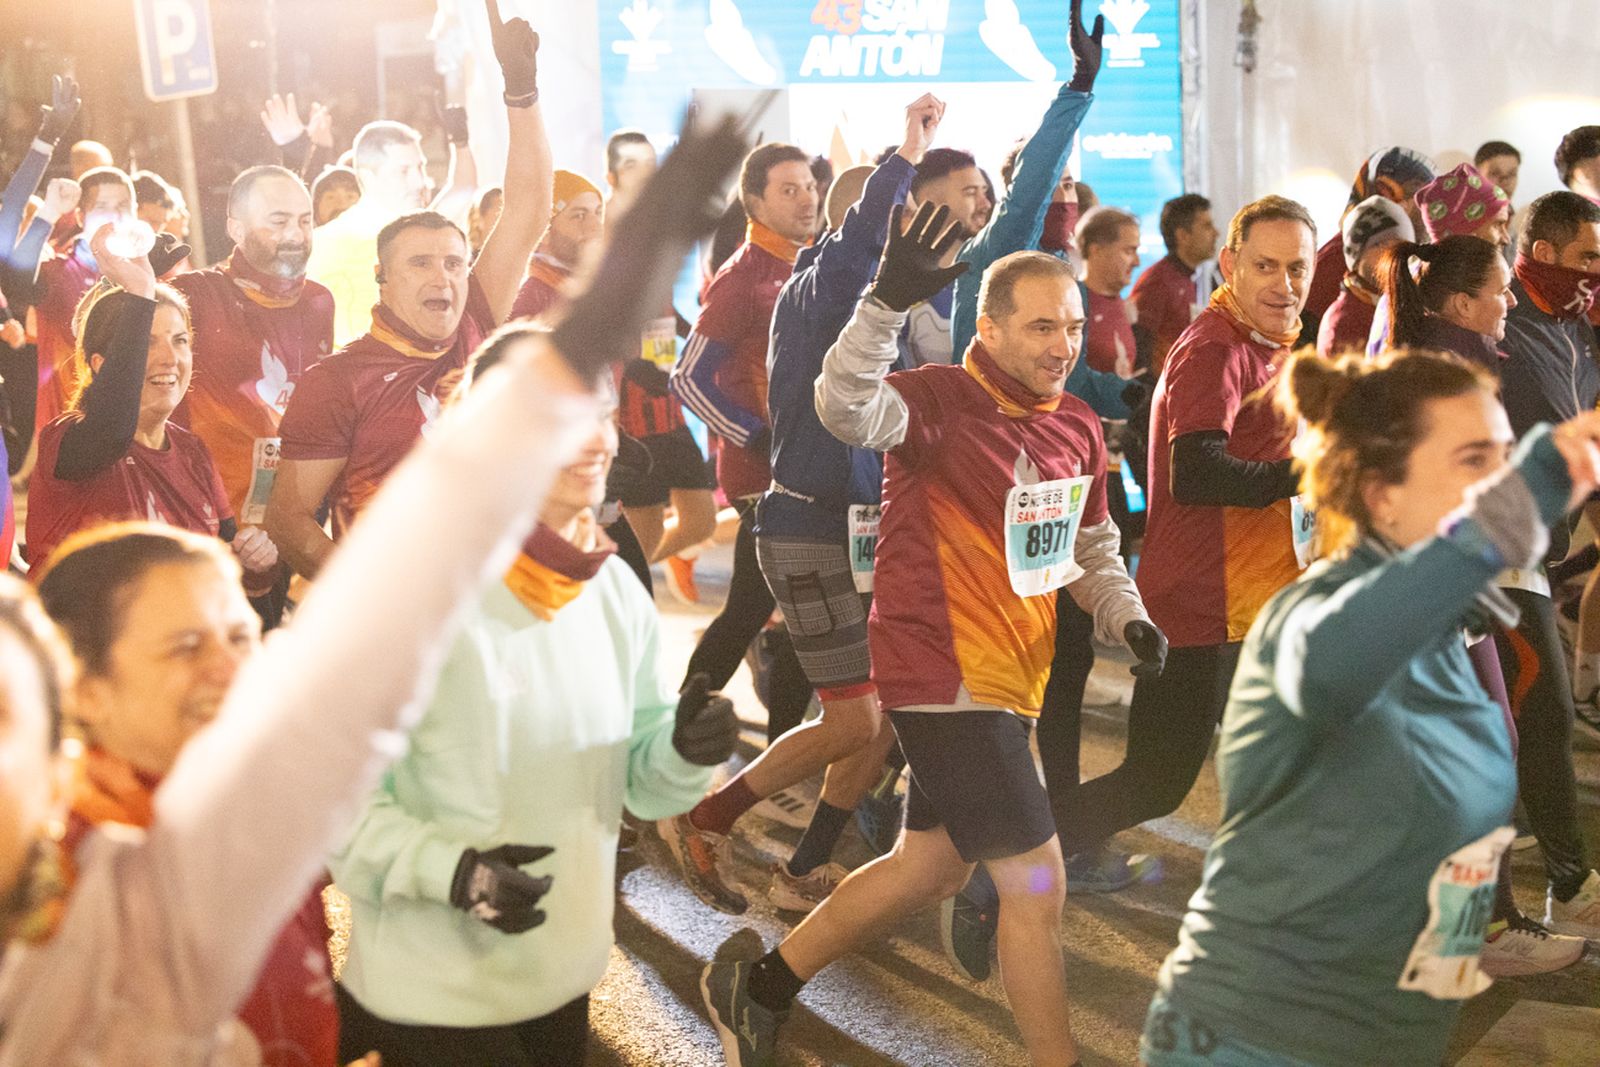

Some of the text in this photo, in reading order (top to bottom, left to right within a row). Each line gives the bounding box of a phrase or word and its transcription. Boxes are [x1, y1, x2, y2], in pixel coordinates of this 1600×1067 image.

[811, 0, 949, 35] 43 SAN
[154, 0, 197, 86] P
[1017, 510, 1037, 523] SAN
[1026, 519, 1070, 558] 8971
